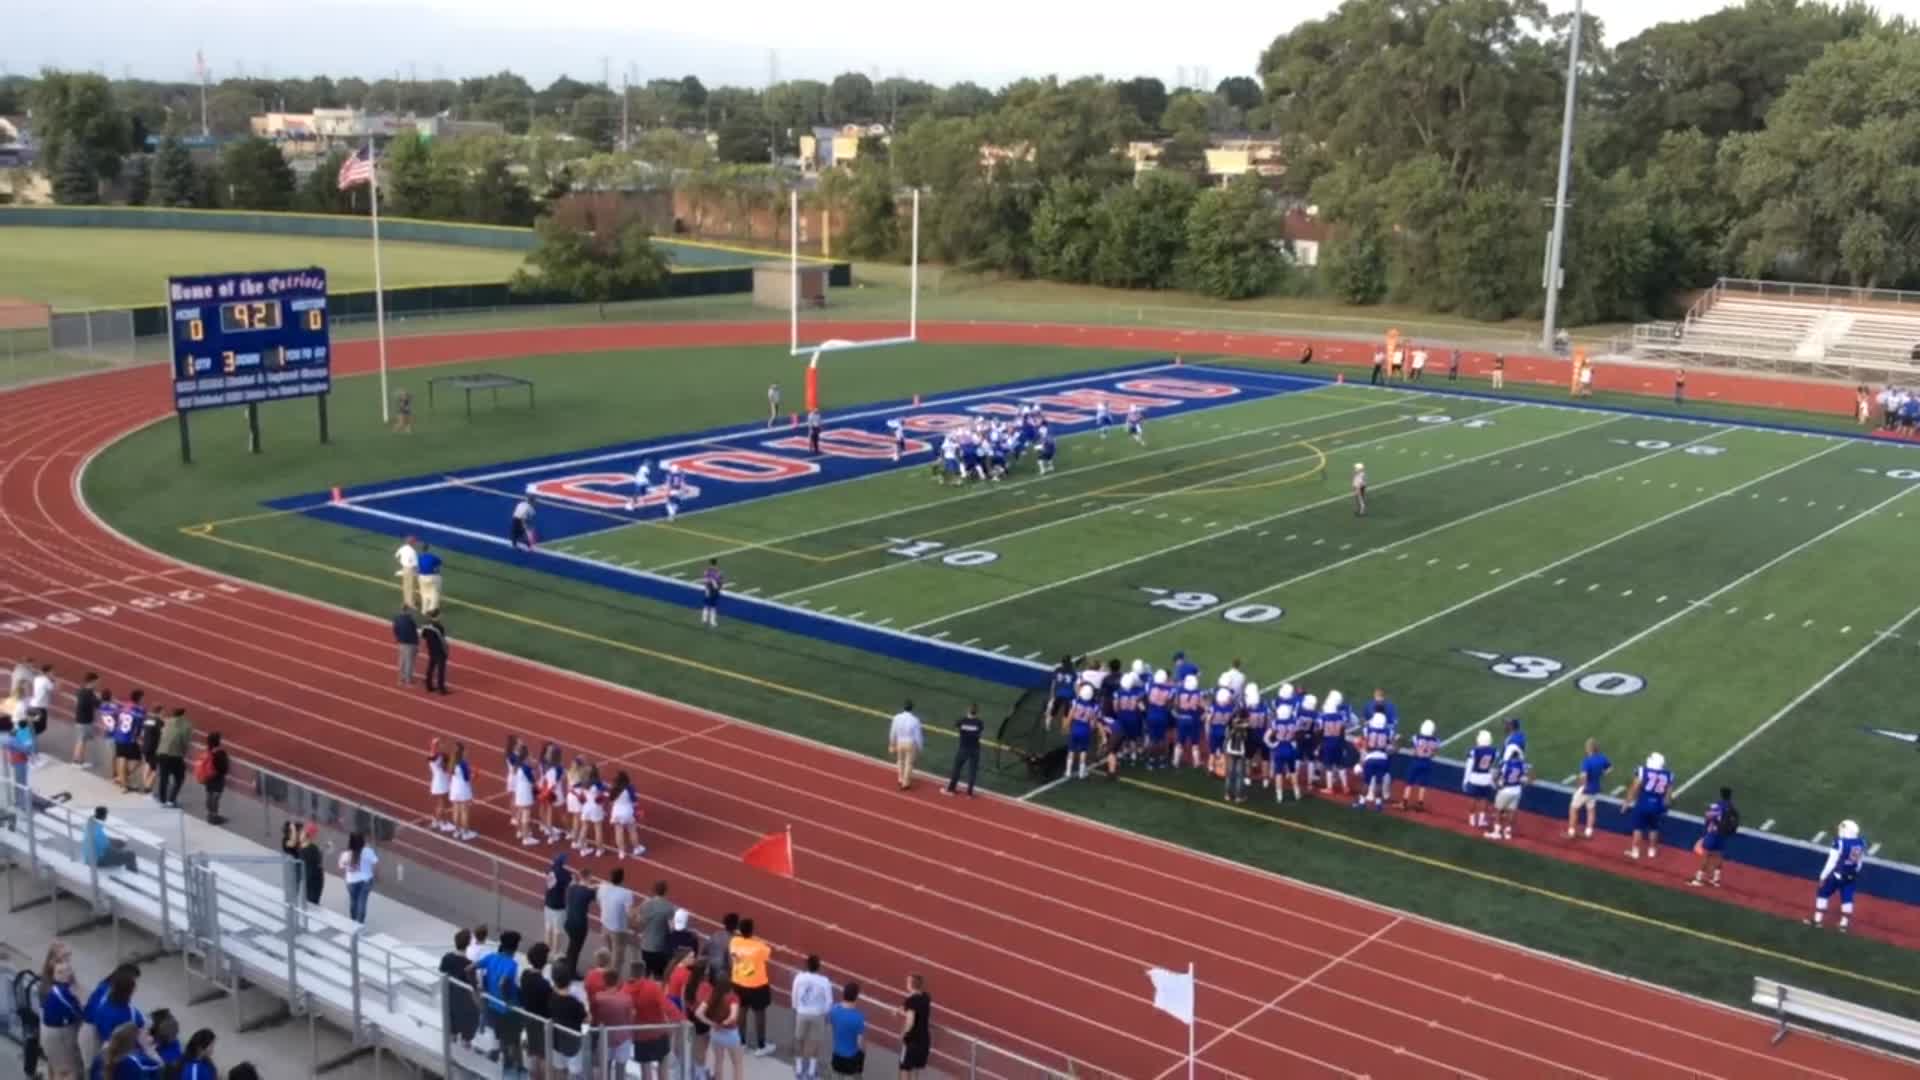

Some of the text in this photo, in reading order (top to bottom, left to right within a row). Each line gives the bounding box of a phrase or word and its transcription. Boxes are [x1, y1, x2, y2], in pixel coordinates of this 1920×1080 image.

[171, 271, 325, 300] Home of the Patriots
[190, 320, 204, 341] 0
[309, 310, 322, 330] 0
[222, 351, 235, 372] 3
[887, 541, 998, 566] 10
[1150, 591, 1282, 624] 20
[1491, 656, 1644, 696] 30
[1645, 771, 1668, 793] 72
